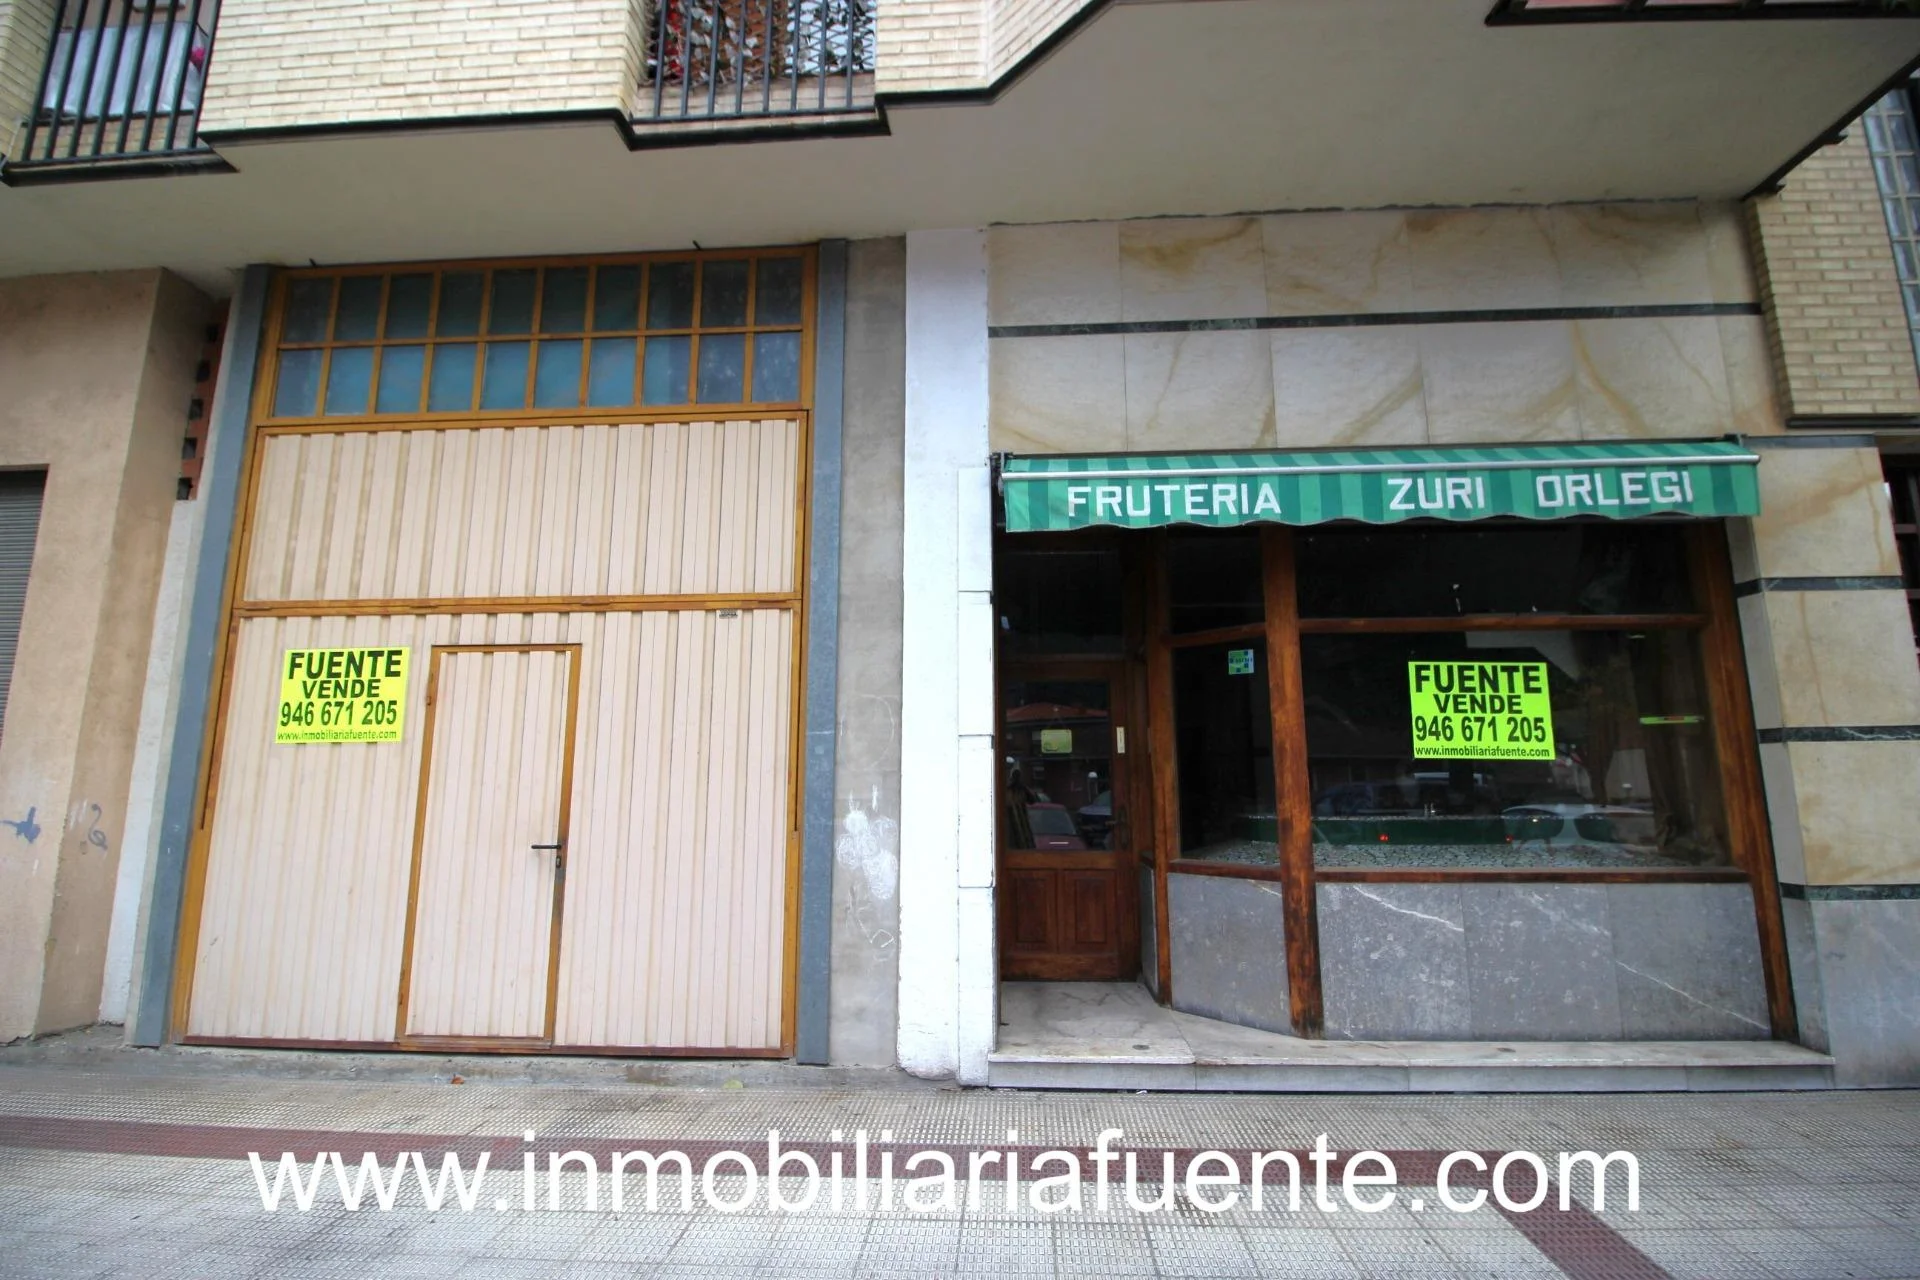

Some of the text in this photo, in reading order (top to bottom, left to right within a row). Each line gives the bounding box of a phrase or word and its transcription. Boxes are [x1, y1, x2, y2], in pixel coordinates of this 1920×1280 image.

[1067, 471, 1693, 517] FRUTERIA ZURI ORLEGI
[288, 650, 402, 679] FUENTE
[302, 679, 381, 698] VENDE
[1414, 664, 1542, 694] FUENTE
[280, 700, 397, 726] 946 671 205
[1433, 694, 1523, 714] VENDE
[277, 729, 397, 740] www.inmobiliariafuente.com
[1414, 716, 1546, 742] 946 671 205
[1415, 745, 1550, 757] www.inmobiliariafuente.com
